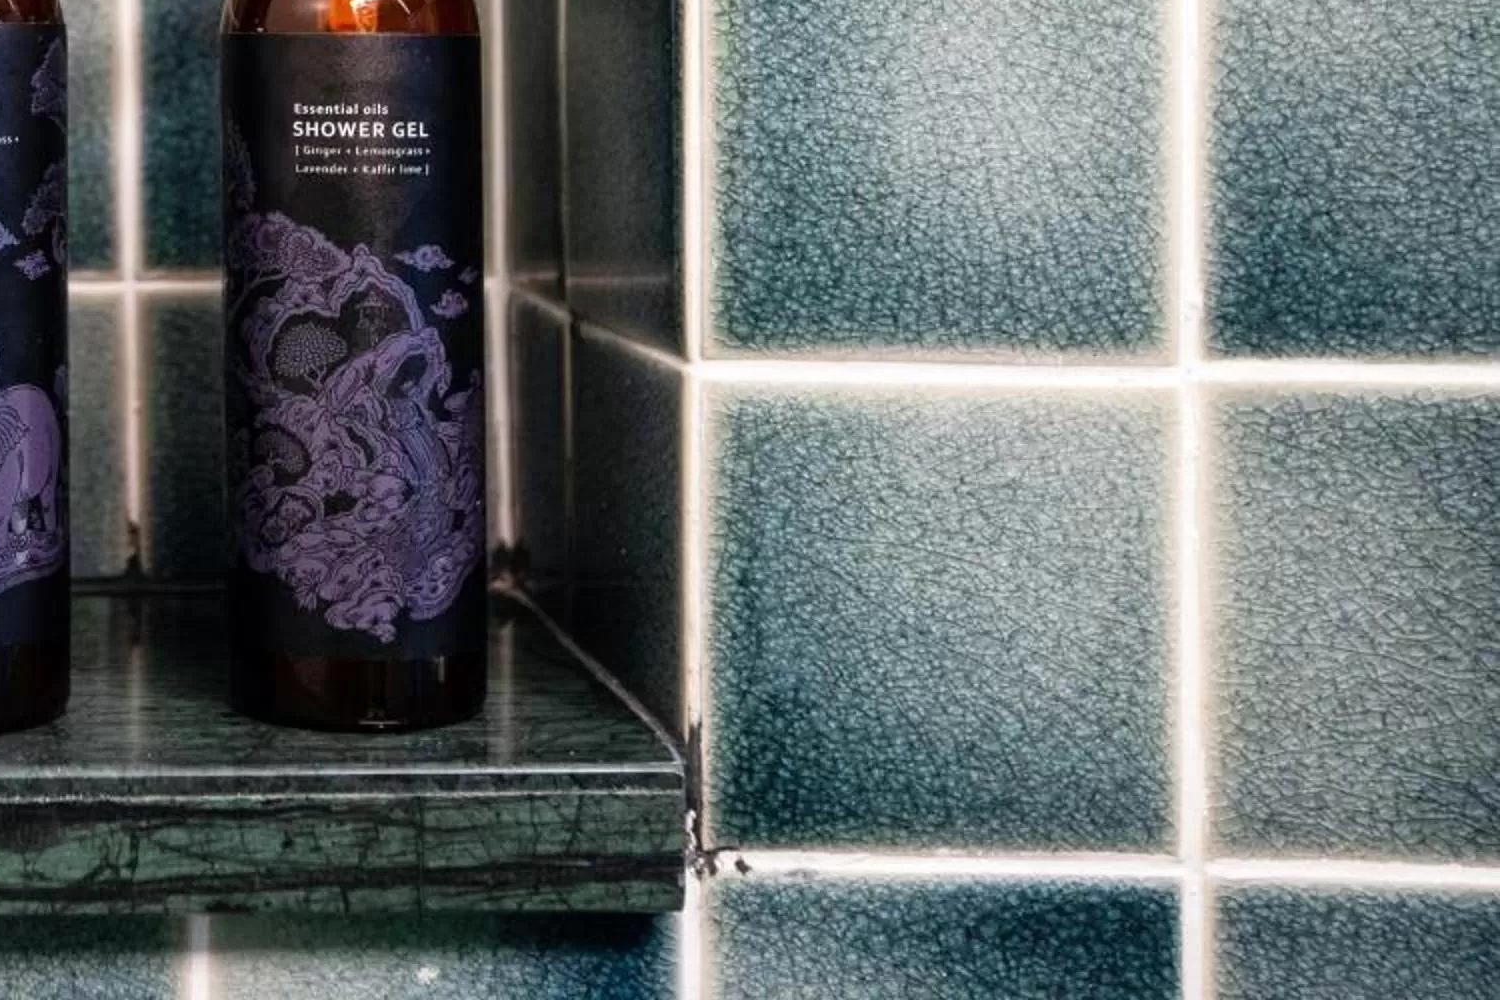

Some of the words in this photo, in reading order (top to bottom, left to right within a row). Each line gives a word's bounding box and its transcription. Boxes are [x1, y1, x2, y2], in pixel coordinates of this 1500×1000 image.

[293, 103, 359, 115] Essential
[362, 103, 389, 115] oils
[292, 121, 385, 138] SHOWER
[391, 121, 430, 138] GEL
[302, 145, 341, 158] Ginger
[355, 145, 424, 158] Lemongrass
[295, 163, 348, 174] Lavender
